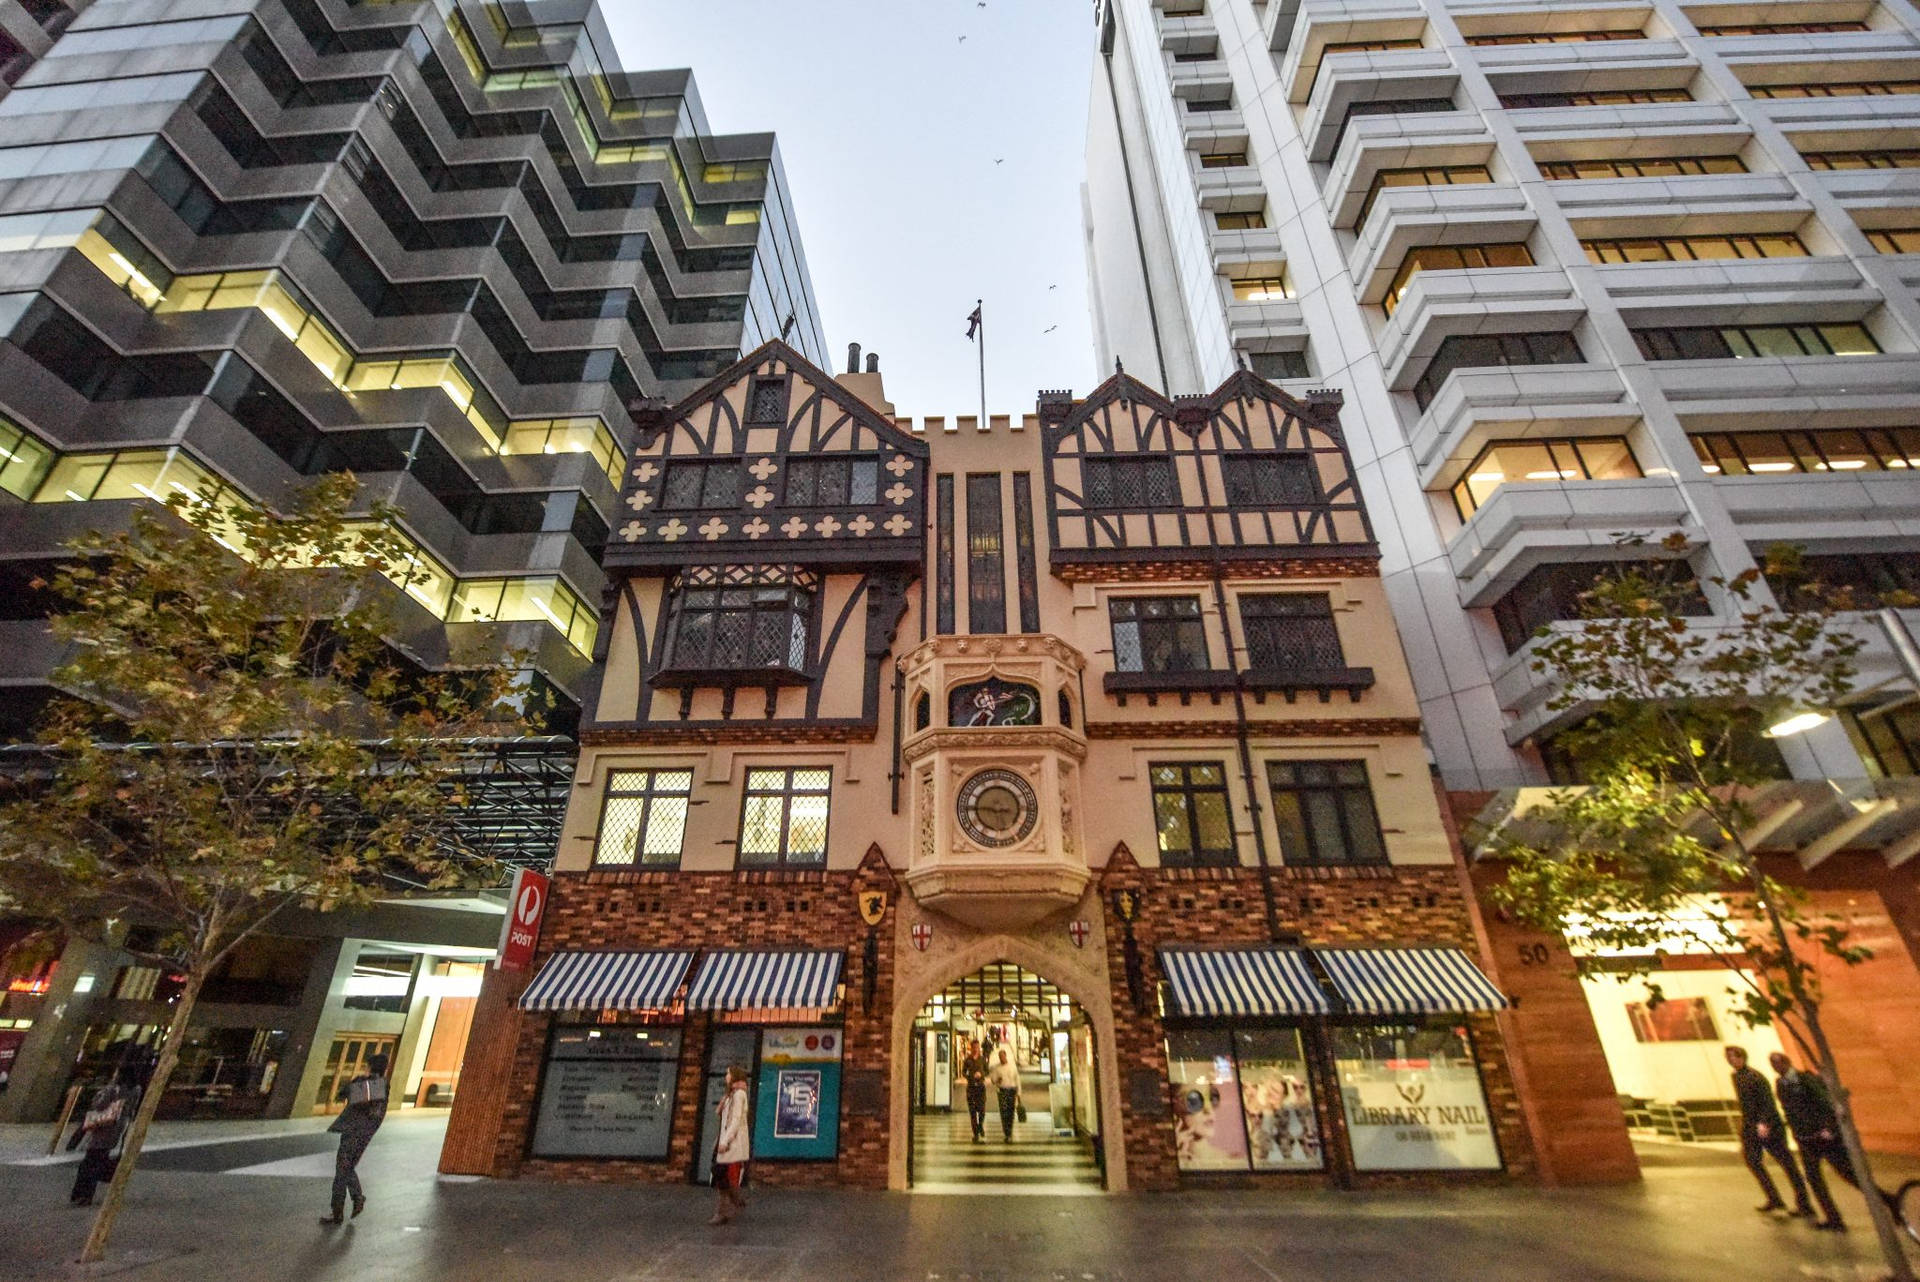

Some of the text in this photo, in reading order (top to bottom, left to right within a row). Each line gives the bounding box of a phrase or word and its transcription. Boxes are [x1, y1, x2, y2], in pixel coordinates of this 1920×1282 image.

[511, 931, 533, 947] POST
[1518, 943, 1549, 966] 50
[1350, 1104, 1486, 1125] LIBRARY NAIL
